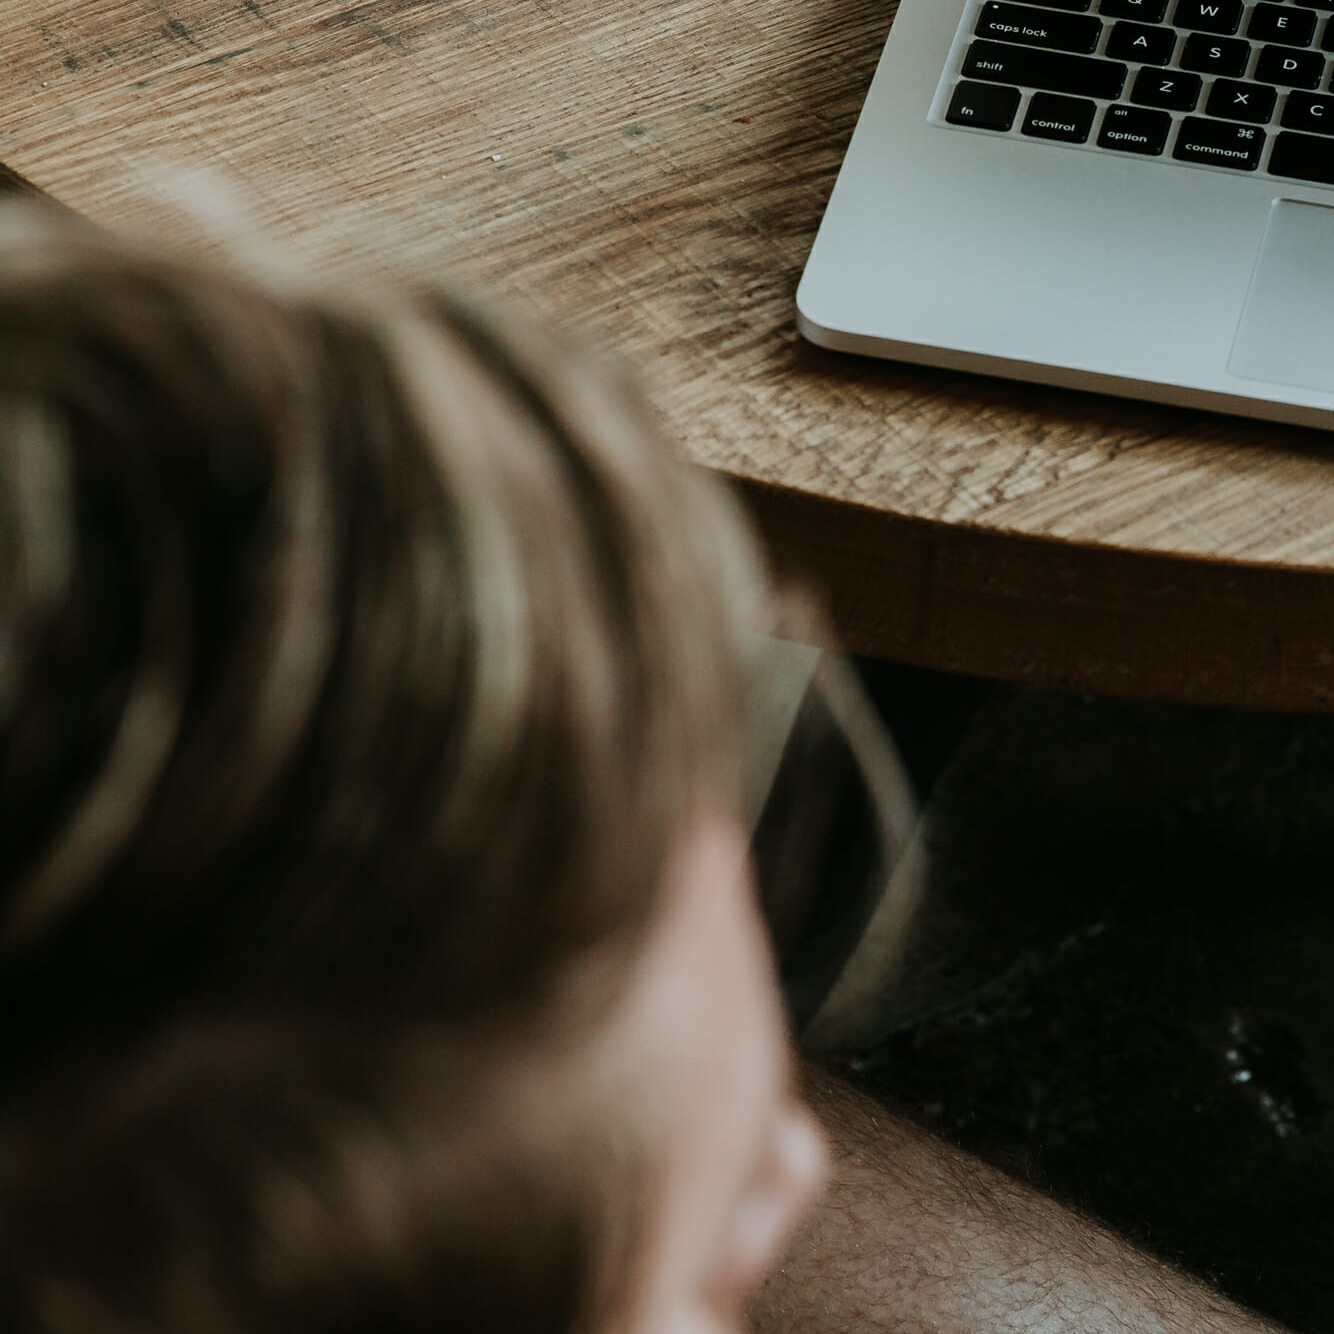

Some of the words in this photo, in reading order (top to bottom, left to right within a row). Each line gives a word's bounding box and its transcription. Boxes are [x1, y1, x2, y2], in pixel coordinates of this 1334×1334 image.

[1199, 3, 1220, 18] W
[1275, 15, 1289, 29] E
[988, 21, 1020, 34] caps
[1021, 25, 1048, 38] lock
[1131, 34, 1148, 48] A
[1208, 46, 1222, 59] S
[974, 60, 1004, 72] shift
[1281, 57, 1299, 71] D
[959, 105, 974, 117] fn
[1030, 118, 1076, 132] control
[1106, 130, 1148, 144] option
[1184, 142, 1250, 160] command
